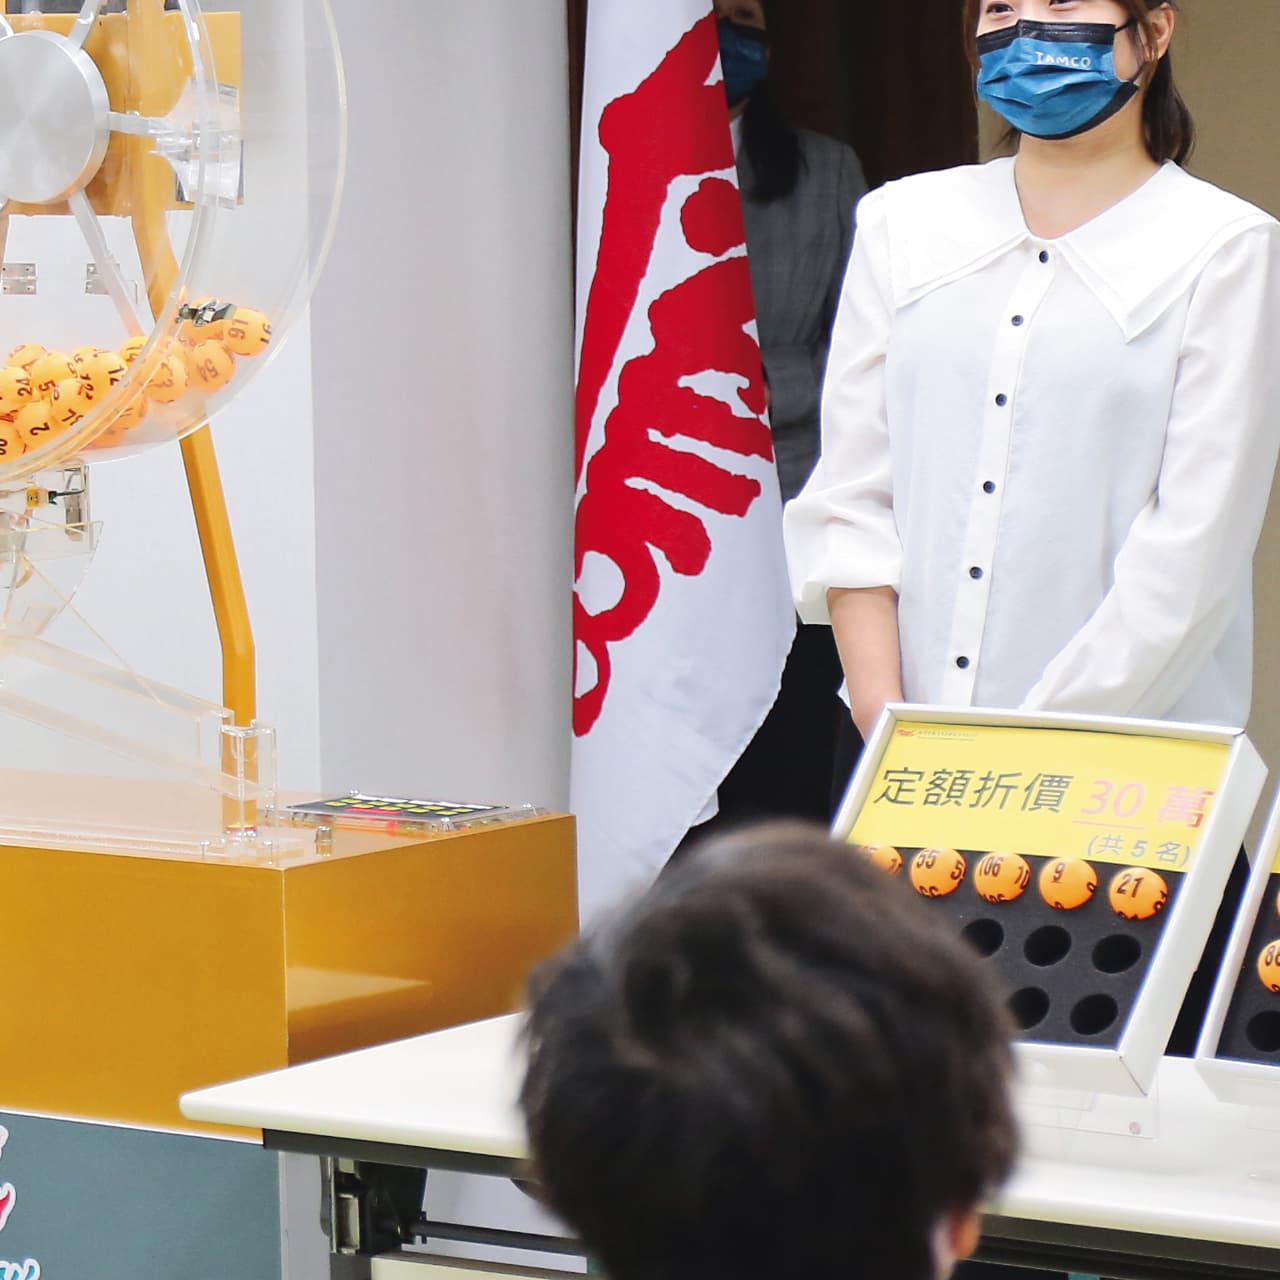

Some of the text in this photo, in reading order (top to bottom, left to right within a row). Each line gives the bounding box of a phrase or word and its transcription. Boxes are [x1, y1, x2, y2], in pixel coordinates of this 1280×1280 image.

[1035, 51, 1091, 68] TAMCO
[15, 377, 33, 402] 24
[873, 766, 1215, 828] 定額折價 30 萬
[1087, 834, 1191, 868] (共 5 名)
[979, 856, 1004, 878] 106
[1052, 862, 1066, 884] 9
[1116, 873, 1144, 898] 21
